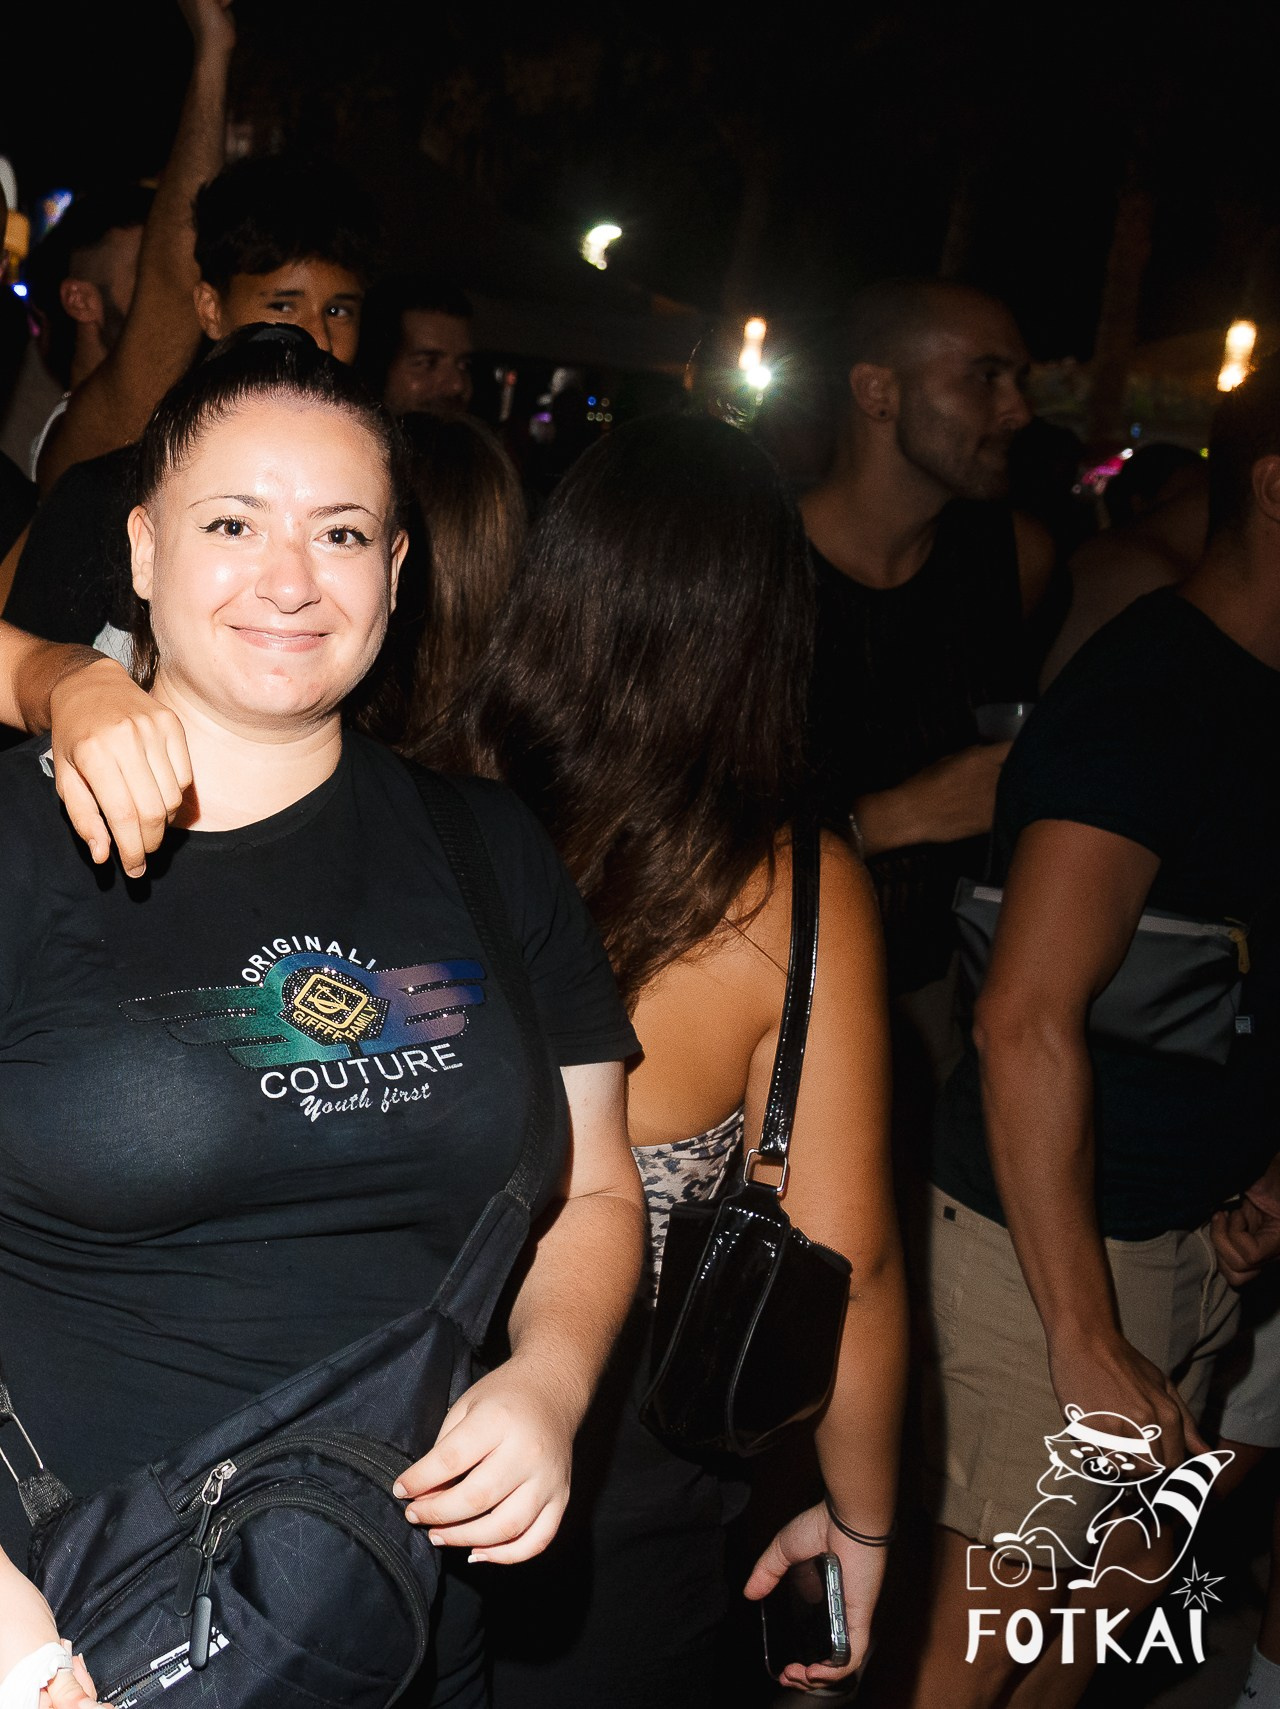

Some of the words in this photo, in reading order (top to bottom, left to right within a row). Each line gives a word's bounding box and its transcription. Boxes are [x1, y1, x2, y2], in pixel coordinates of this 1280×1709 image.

[344, 1004, 378, 1040] FAMILY
[260, 1042, 464, 1099] COUTURE
[299, 1087, 373, 1123] Youth
[380, 1081, 432, 1114] first
